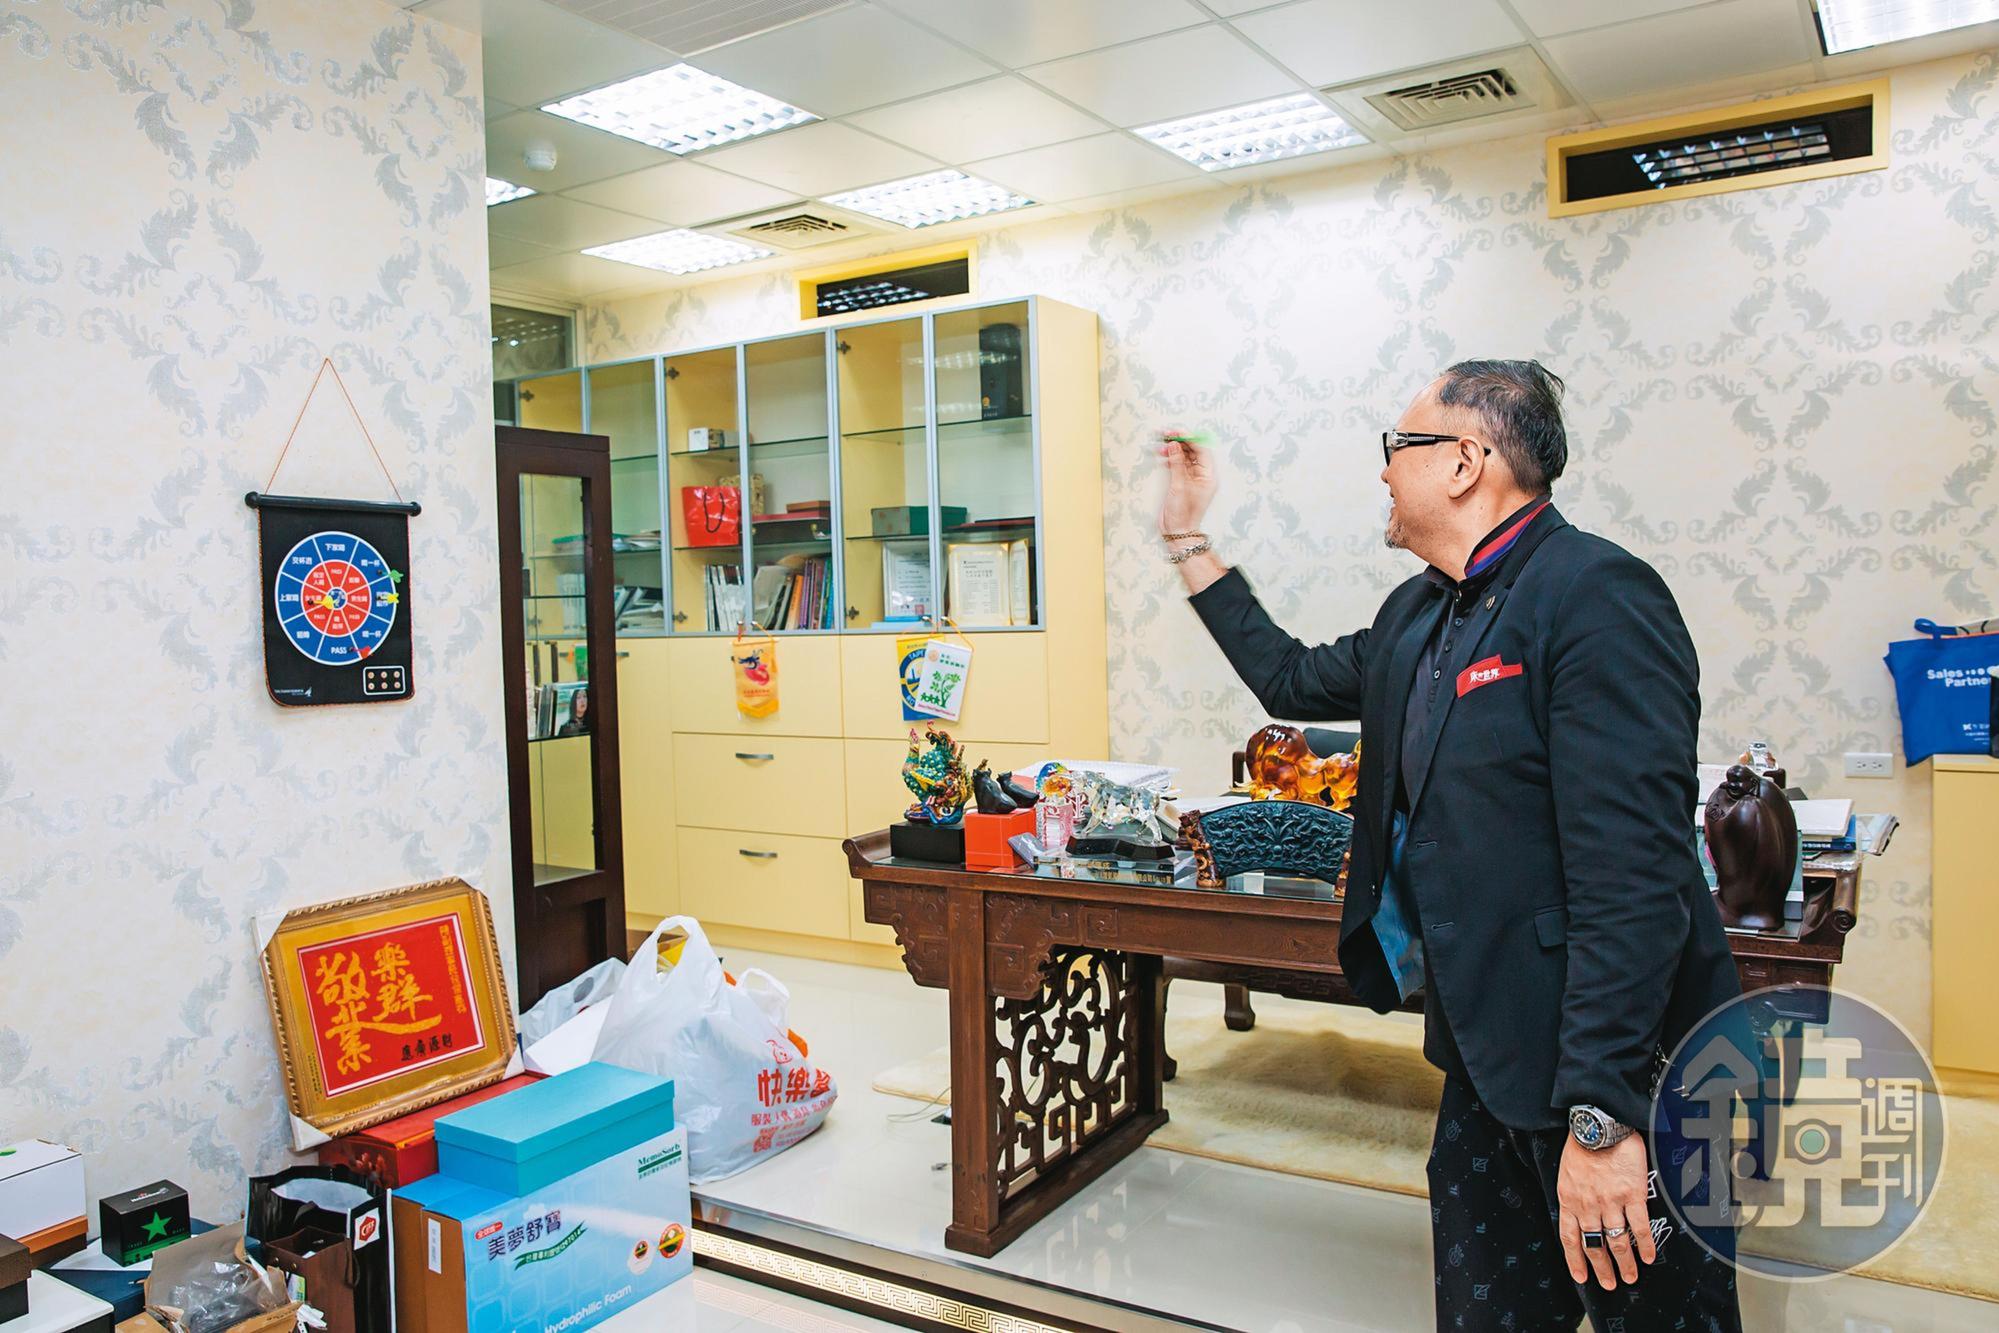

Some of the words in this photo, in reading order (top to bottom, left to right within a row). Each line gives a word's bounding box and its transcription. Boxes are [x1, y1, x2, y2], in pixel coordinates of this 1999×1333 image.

[331, 647, 347, 655] PASS
[1927, 669, 1964, 680] Sales
[544, 1300, 602, 1333] Hydrophilic
[604, 1284, 633, 1306] Foam
